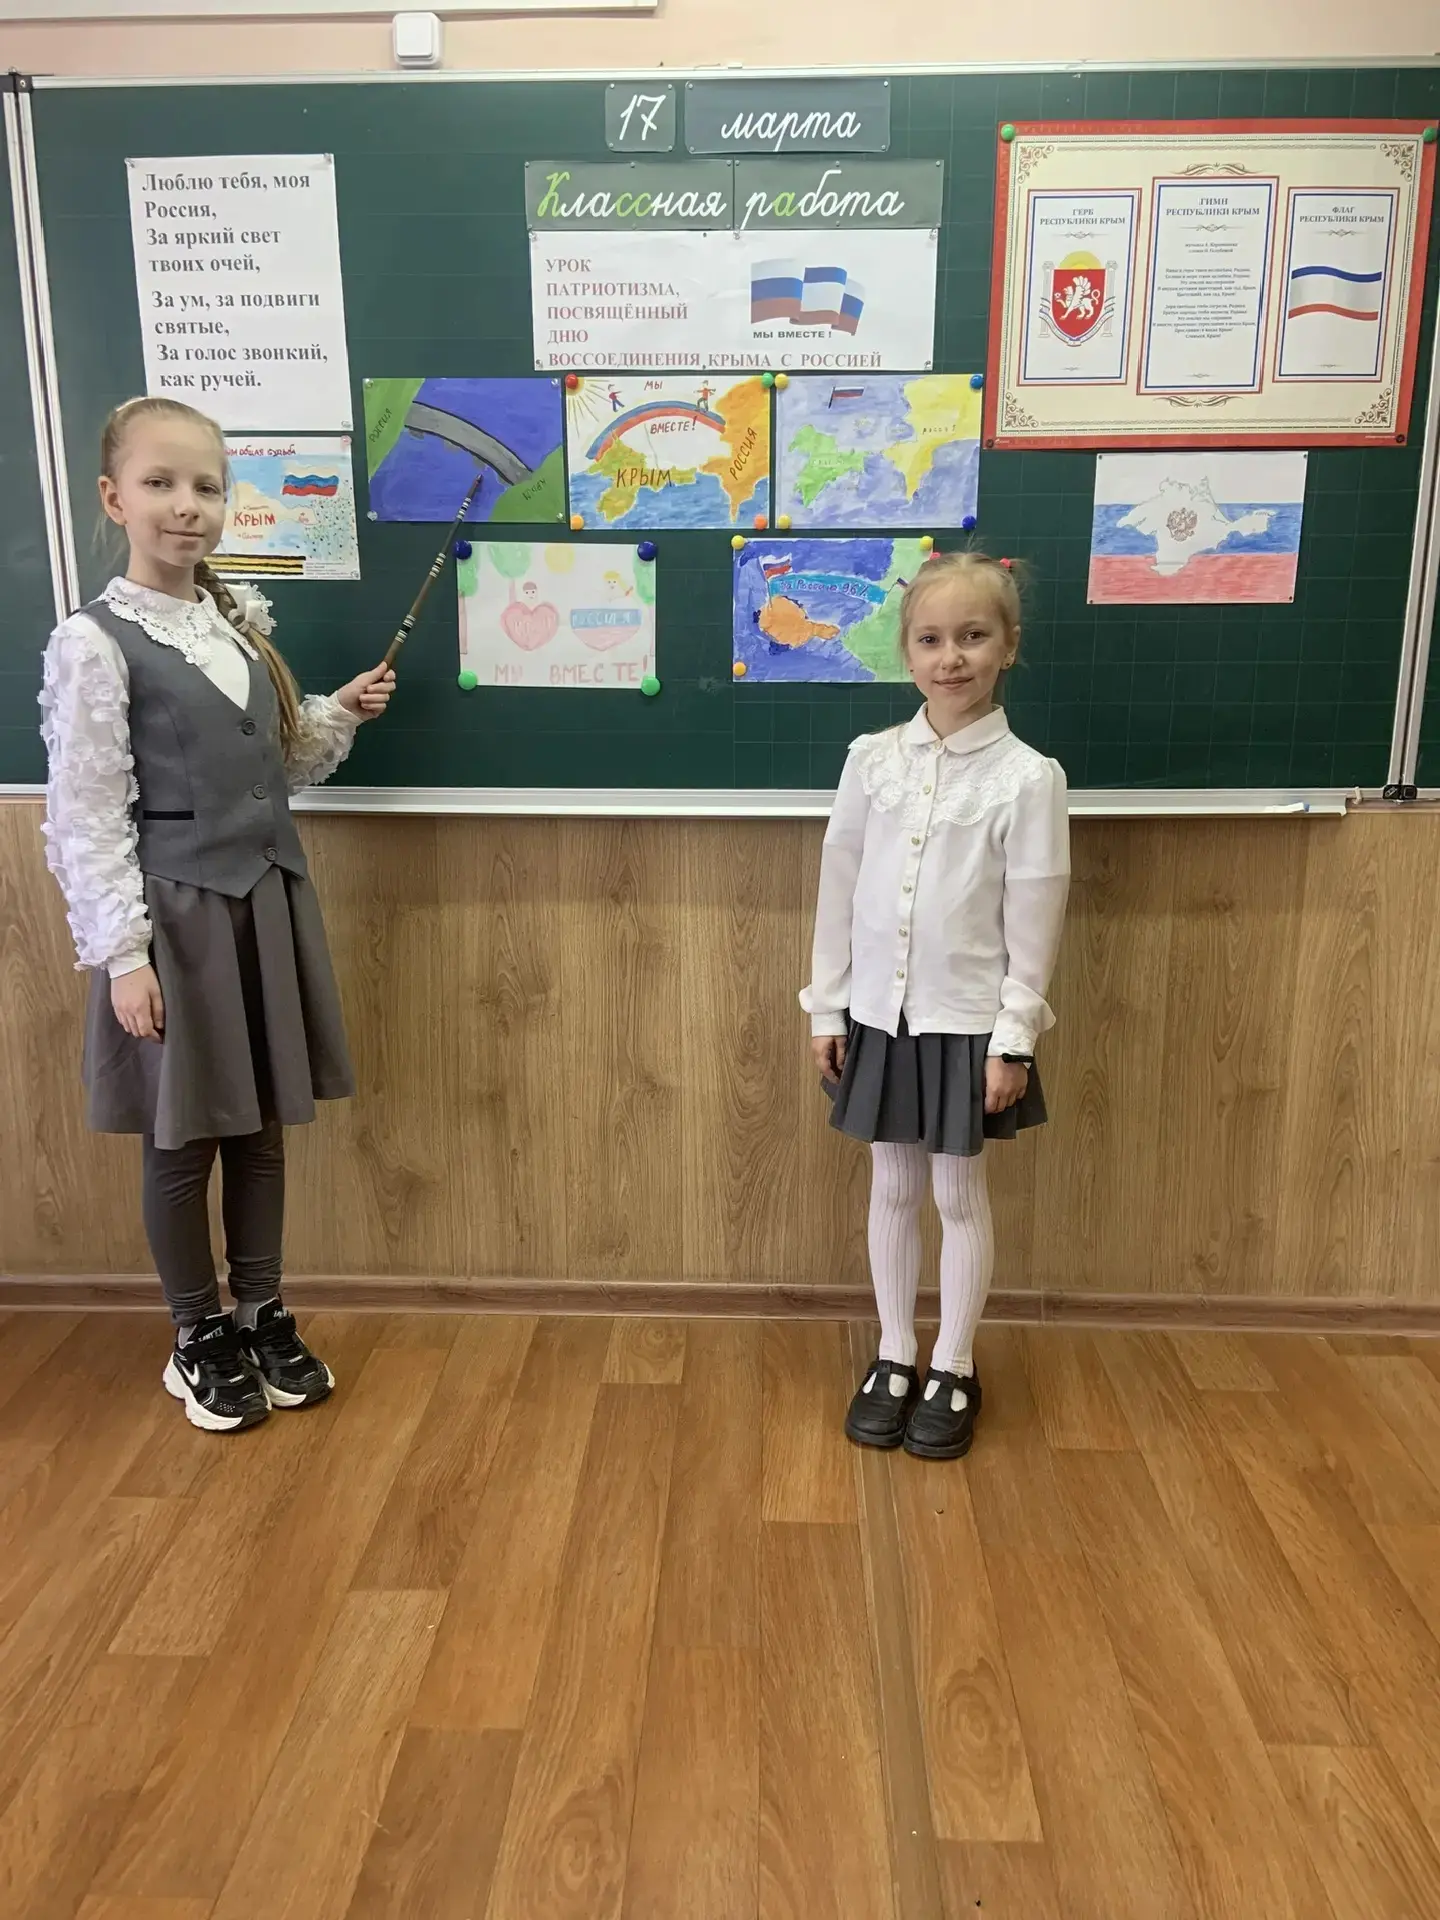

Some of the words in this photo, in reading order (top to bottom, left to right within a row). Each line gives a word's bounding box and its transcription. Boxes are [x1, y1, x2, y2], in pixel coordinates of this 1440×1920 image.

[619, 94, 667, 141] 17
[720, 109, 862, 152] марта
[141, 173, 214, 192] Люблю
[218, 172, 268, 191] тебя,
[273, 174, 311, 188] моя
[536, 171, 727, 218] Классная
[740, 169, 905, 230] работа
[1200, 197, 1228, 205] ГИМН
[144, 201, 217, 220] Россия,
[1072, 208, 1095, 216] ГЕРБ
[1165, 208, 1229, 216] РЕСПУБЛИКИ
[1231, 207, 1260, 215] КРЫМ
[1299, 214, 1358, 223] РЕСПУБЛИКИ
[1359, 214, 1385, 223] КРЫМ
[1331, 206, 1356, 215] ФЛАГ
[1039, 217, 1098, 225] РЕСПУБЛИКИ
[1099, 216, 1126, 225] КРЫМ
[146, 228, 168, 246] За
[174, 227, 235, 250] яркий
[240, 229, 281, 244] свет
[149, 257, 205, 273] твоих
[210, 254, 261, 273] очей,
[545, 258, 591, 273] УРОК
[546, 282, 680, 298] ПАТРИОТИЗМА,
[151, 290, 174, 309] За
[179, 294, 211, 312] ум,
[215, 294, 235, 307] за
[240, 293, 320, 308] подвиги
[547, 304, 688, 322] ПОСВЯЩЁННЫЙ
[154, 321, 230, 336] святые,
[547, 329, 588, 346] ДНЮ
[156, 344, 179, 361] За
[185, 347, 237, 361] голос
[242, 344, 328, 363] звонкий,
[548, 352, 701, 368] ВОССОЕДИНЕНИЯ
[708, 353, 771, 368] КРЫМА
[781, 353, 793, 368] С
[801, 350, 882, 369] РОССИЕЙ
[160, 373, 195, 387] как
[200, 371, 262, 391] ручей.
[644, 380, 663, 390] МЫ
[650, 415, 698, 434] ВМЕСТЕ!
[729, 427, 758, 480] РОССИЯ
[616, 468, 673, 488] КРЫМ
[233, 511, 276, 527] КРЫМ
